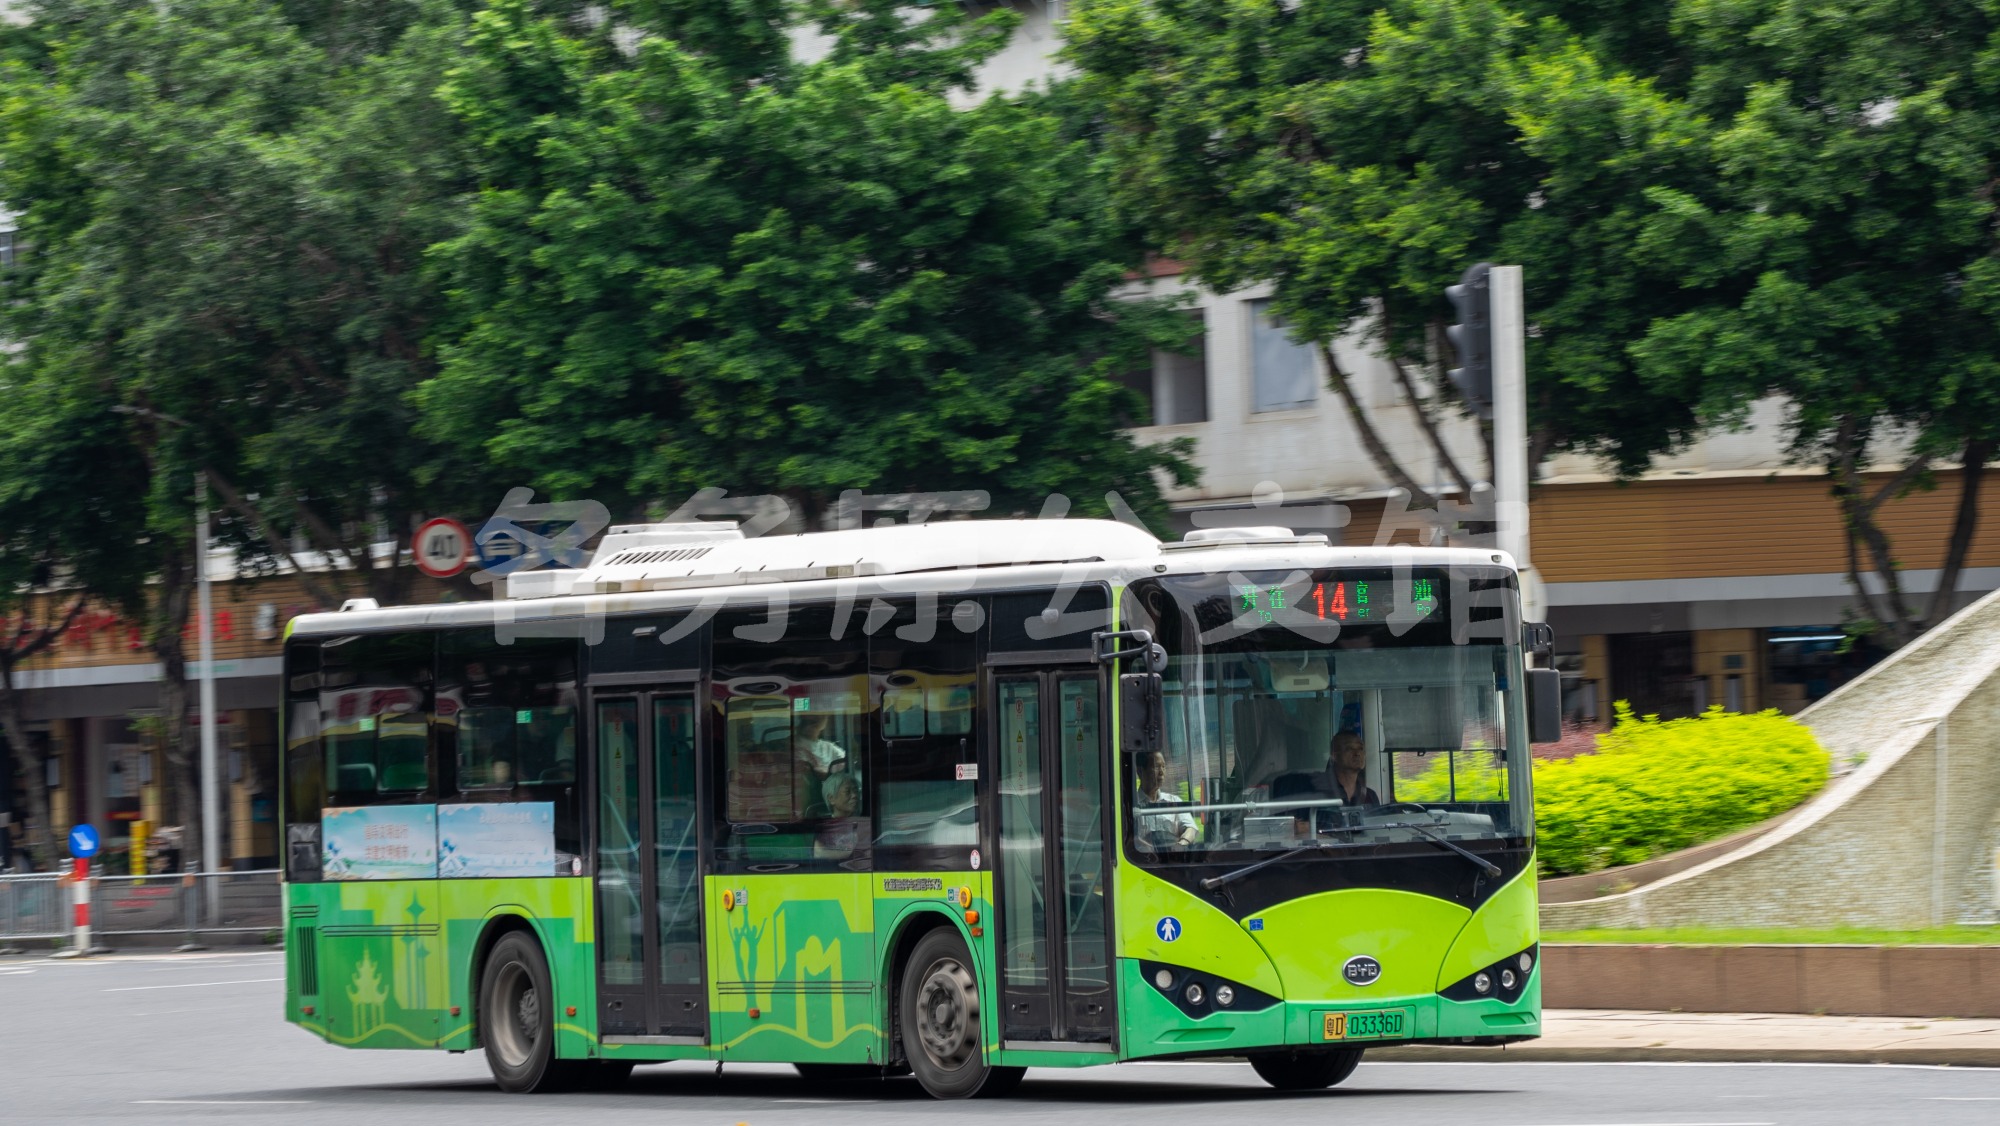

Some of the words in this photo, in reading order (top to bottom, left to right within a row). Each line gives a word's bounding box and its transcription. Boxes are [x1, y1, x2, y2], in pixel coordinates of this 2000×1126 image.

[1241, 584, 1287, 610] 开往
[1312, 582, 1349, 621] 14
[1257, 609, 1273, 623] To
[1347, 963, 1378, 978] BYD
[1350, 1014, 1402, 1035] 03336D
